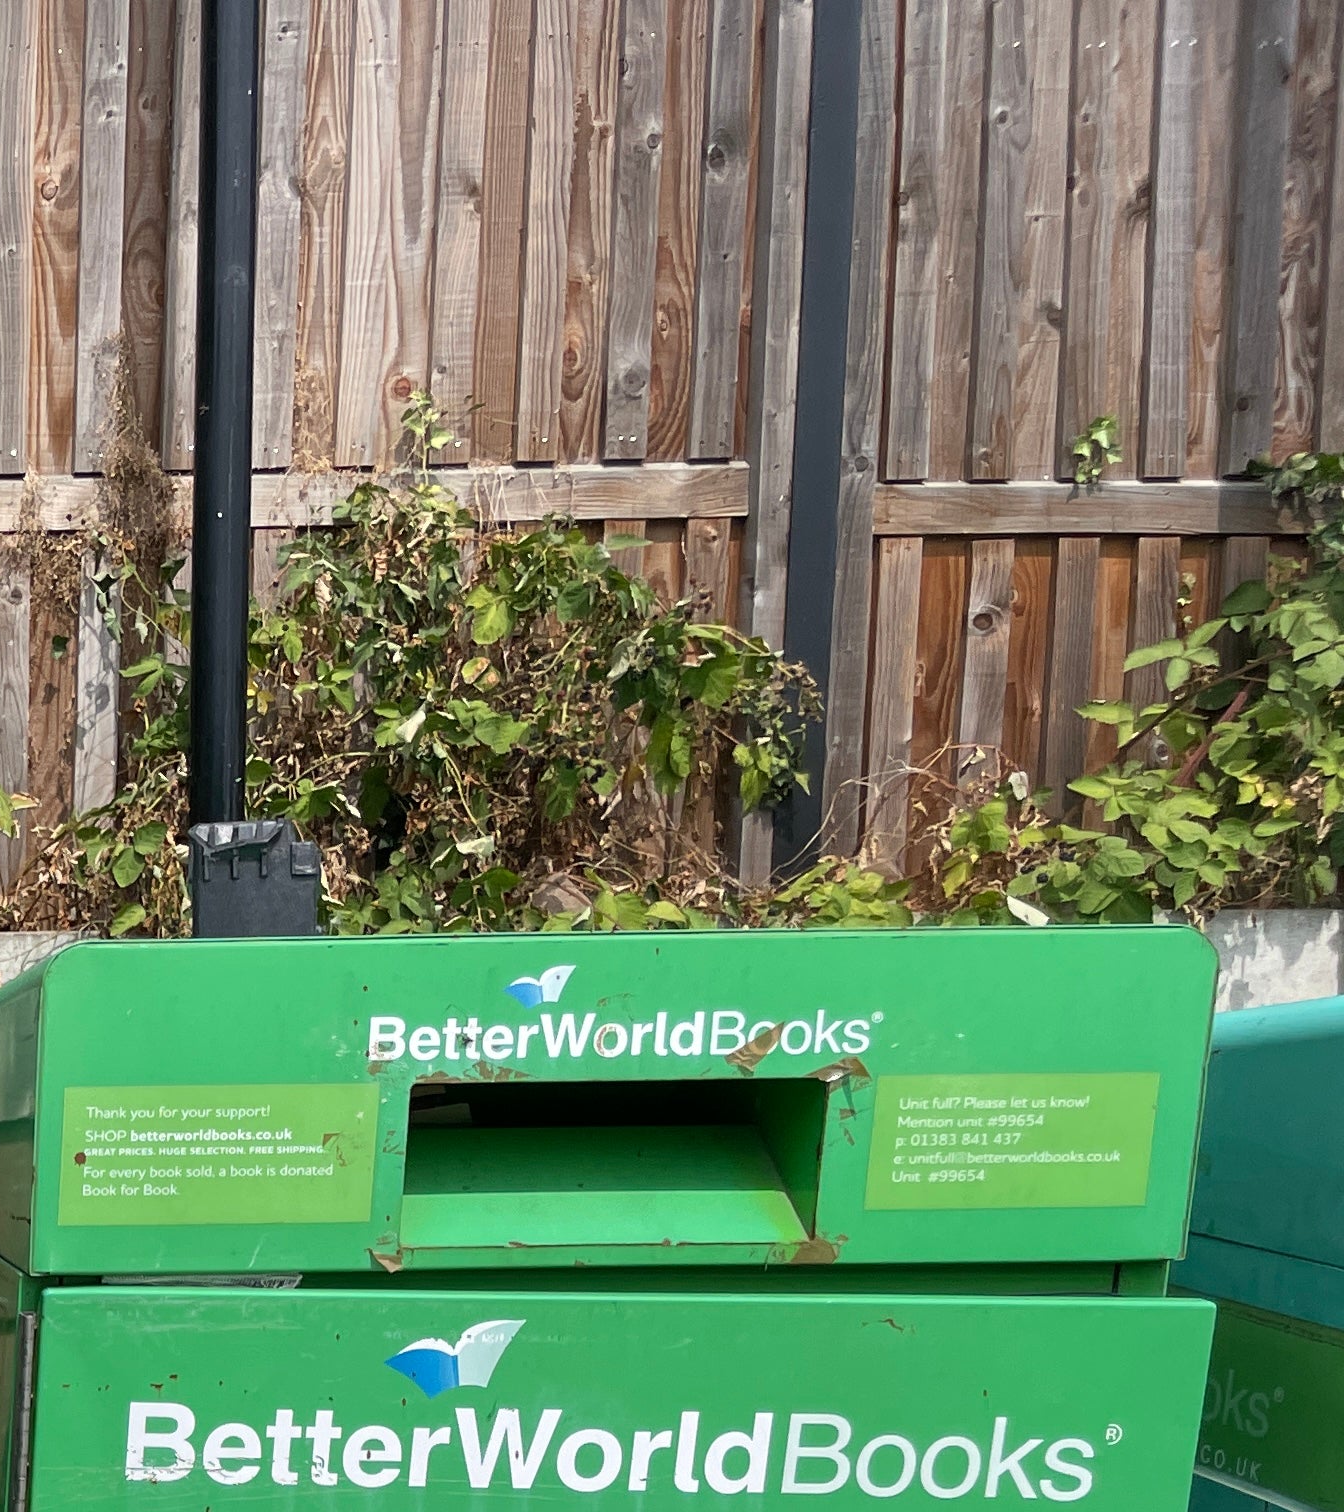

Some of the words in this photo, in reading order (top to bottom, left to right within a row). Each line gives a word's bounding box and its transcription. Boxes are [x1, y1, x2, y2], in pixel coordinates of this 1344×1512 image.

[86, 1106, 126, 1119] Thank
[130, 1108, 155, 1122] you
[159, 1106, 177, 1119] for
[181, 1109, 212, 1121] your
[215, 1105, 271, 1120] support!
[898, 1116, 953, 1128] Mention
[957, 1116, 983, 1128] unit
[987, 1115, 1044, 1127] #99654
[85, 1130, 127, 1143] SHOP
[131, 1128, 292, 1142] betterworldbooks.co.uk
